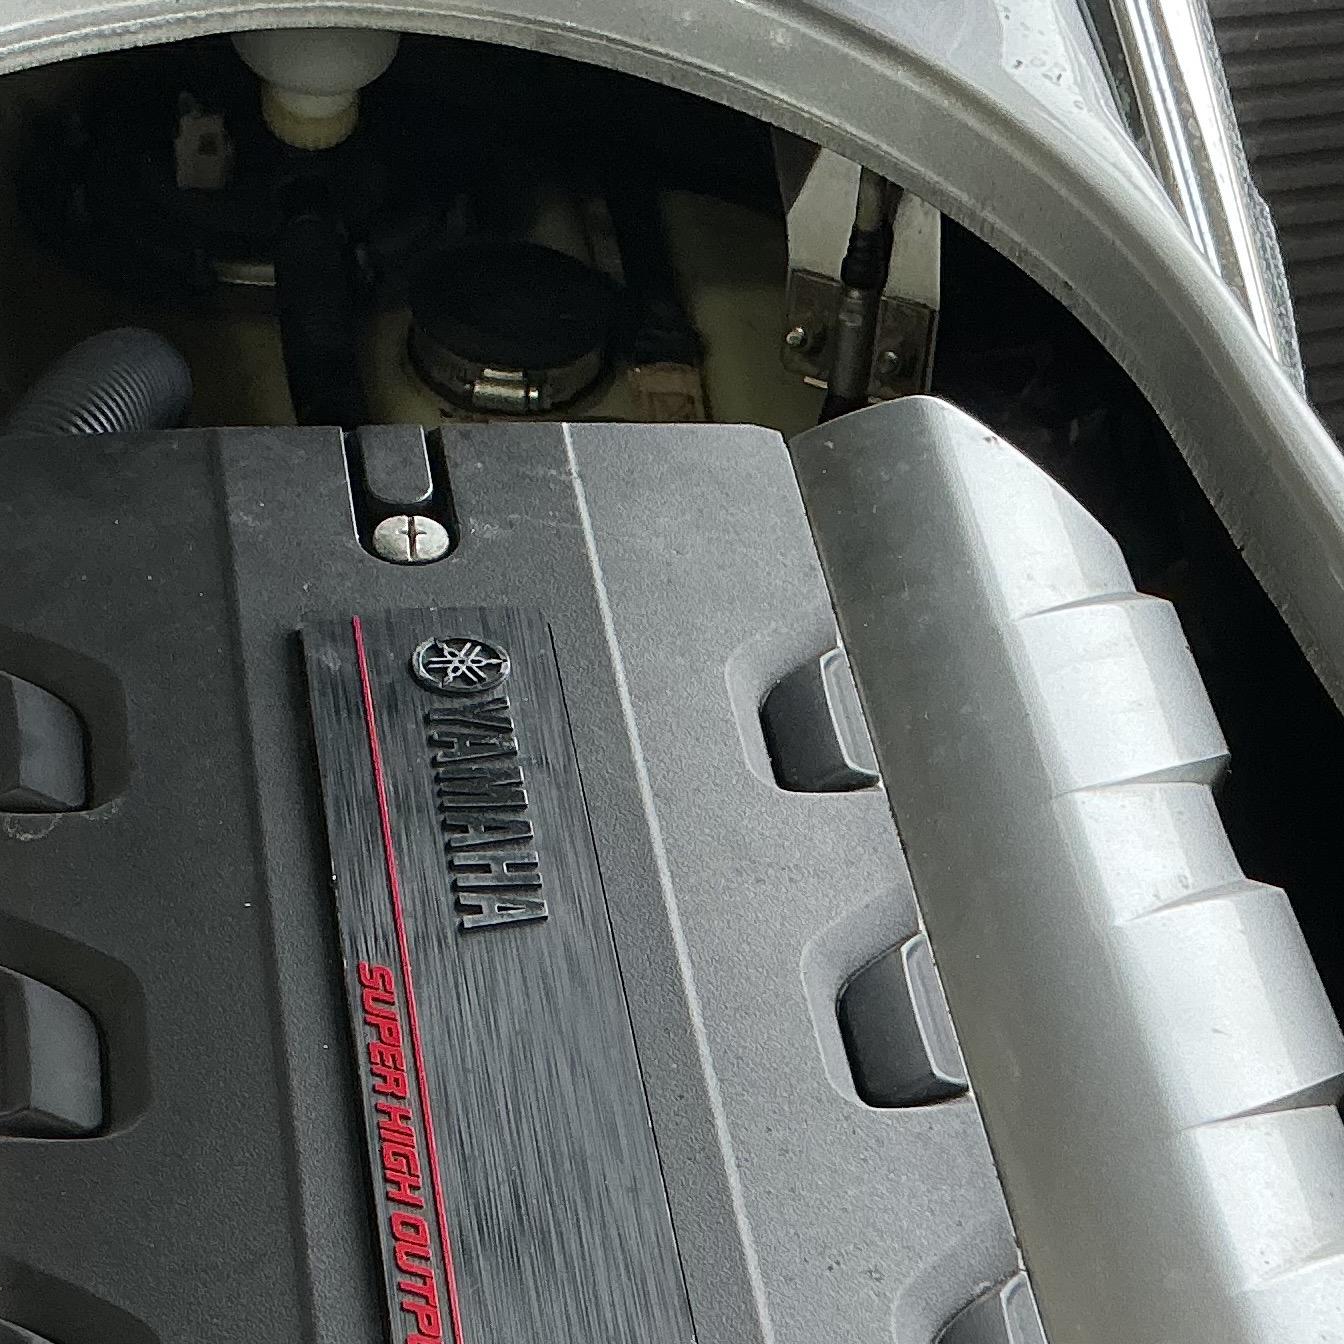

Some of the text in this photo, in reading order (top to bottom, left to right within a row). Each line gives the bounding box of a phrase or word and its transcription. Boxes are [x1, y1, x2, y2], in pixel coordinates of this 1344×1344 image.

[425, 696, 548, 930] YAMAHA
[357, 961, 408, 1109] SUPER
[375, 1101, 424, 1209] HIGH
